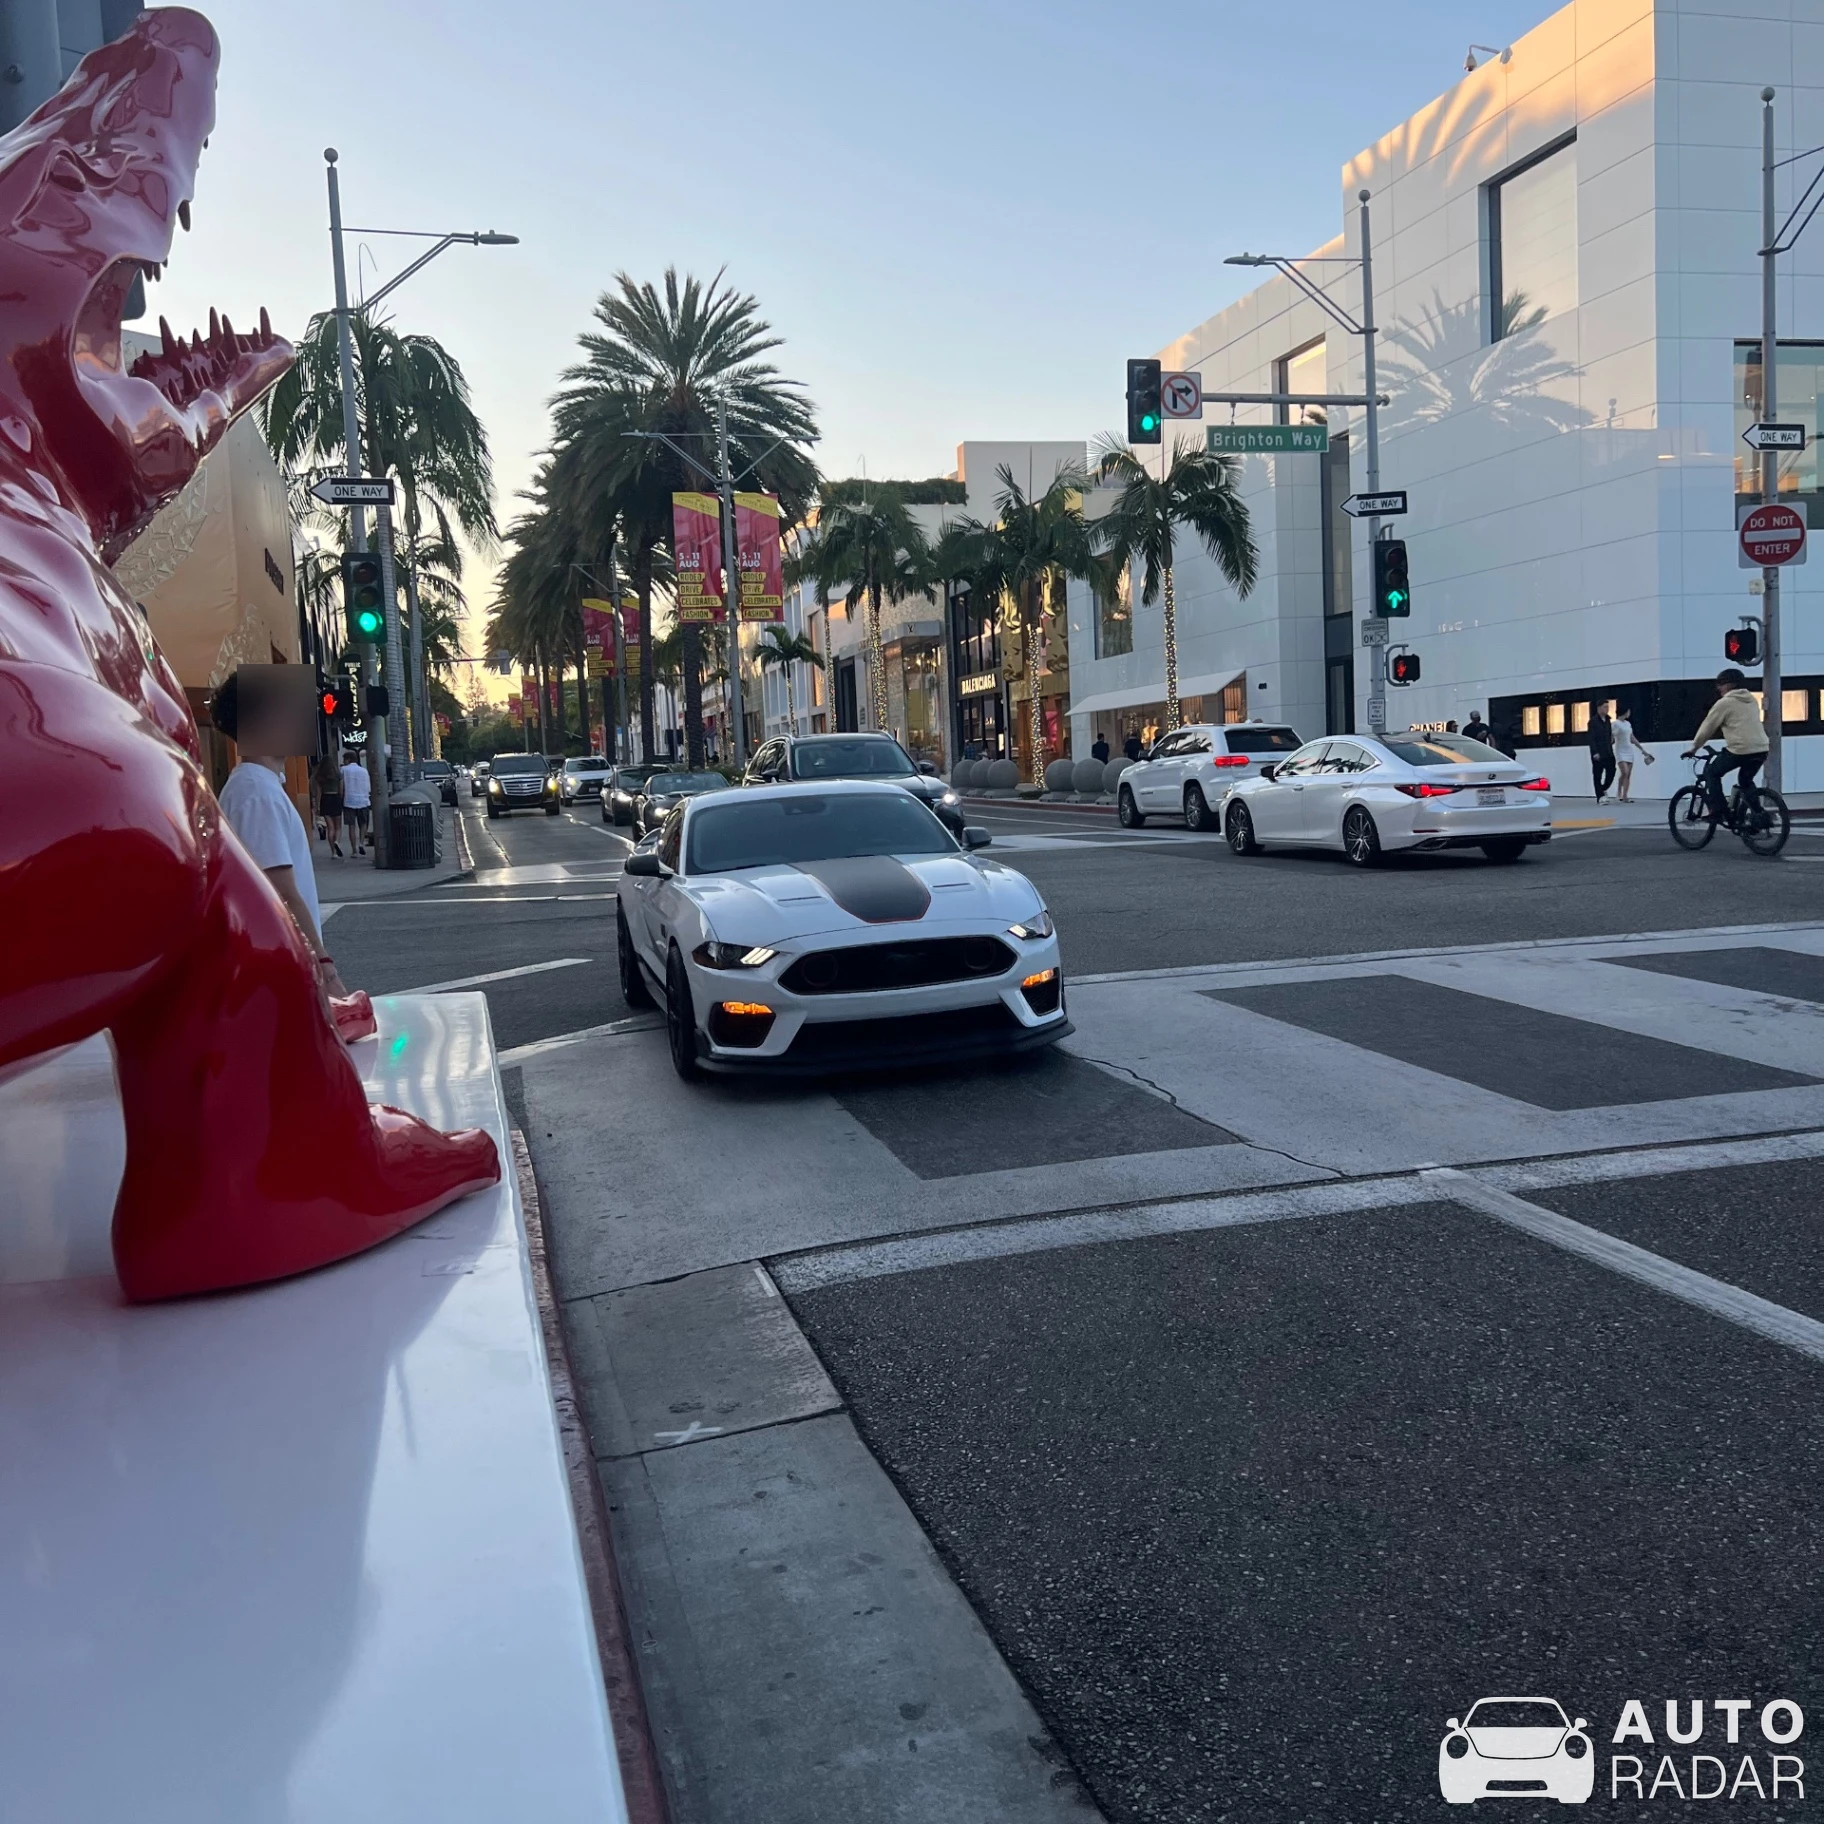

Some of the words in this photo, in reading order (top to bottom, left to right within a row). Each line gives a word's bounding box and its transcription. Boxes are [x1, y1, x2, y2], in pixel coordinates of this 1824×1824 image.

[1213, 432, 1283, 450] Brighton
[1292, 432, 1321, 449] Way
[1760, 432, 1777, 442] ONE
[1780, 432, 1797, 442] WAY
[334, 486, 357, 496] ONE
[361, 486, 383, 497] WAY
[1360, 500, 1377, 510] ONE
[1381, 499, 1398, 508] WAY
[1750, 518, 1766, 528] DO
[1772, 516, 1795, 527] NOT
[1754, 544, 1791, 556] ENTER
[742, 552, 748, 560] 5
[679, 560, 700, 568] AUG
[742, 560, 761, 568] AUG
[680, 573, 702, 581] RODEO
[742, 572, 763, 581] RODEO
[681, 586, 700, 594] DRIVE
[744, 585, 762, 593] DRIVE
[681, 597, 718, 606] CELEBRATES
[744, 597, 779, 605] CELEBRATES
[682, 610, 709, 619] FASHION
[744, 610, 770, 618] FASHION
[1364, 634, 1374, 644] OK
[962, 673, 996, 695] BALENCIAGA
